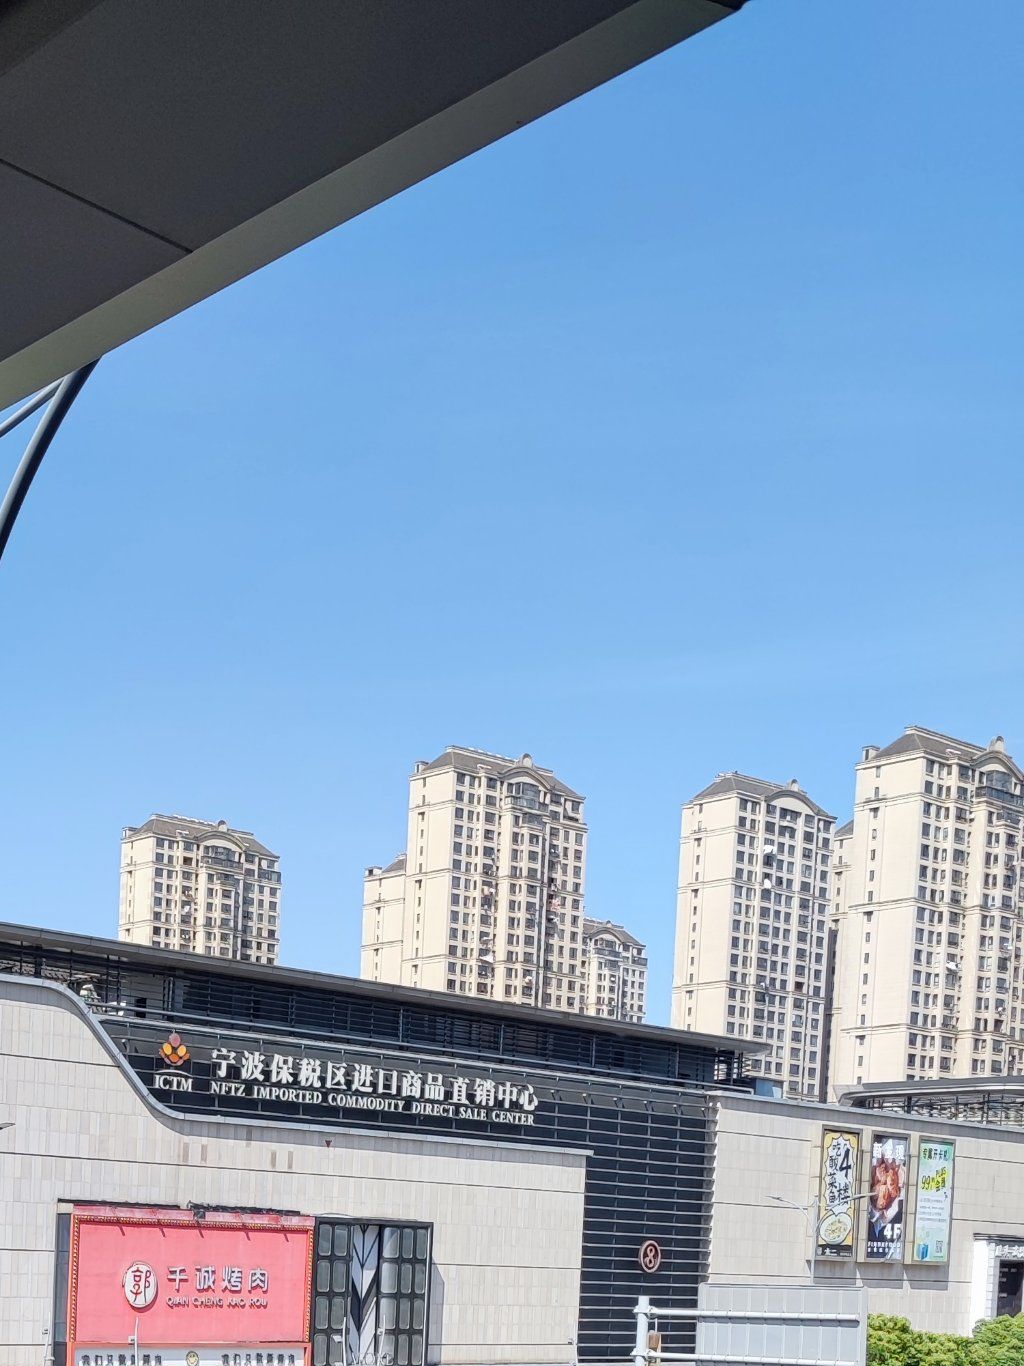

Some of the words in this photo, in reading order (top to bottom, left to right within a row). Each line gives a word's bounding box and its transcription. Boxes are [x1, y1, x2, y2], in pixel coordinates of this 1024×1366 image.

[154, 1074, 193, 1092] ICTM
[211, 1047, 538, 1110] 宁波保税区进口商品直销中心
[210, 1081, 246, 1097] NFTZ
[253, 1085, 322, 1104] IMPORTED
[328, 1093, 405, 1112] COMMODITY
[412, 1101, 454, 1118] DIRECT
[459, 1107, 487, 1120] SALE
[492, 1110, 535, 1126] CENTER
[167, 1265, 269, 1293] 千诚烤肉
[166, 1297, 189, 1309] QIAN
[192, 1297, 223, 1308] CHENG
